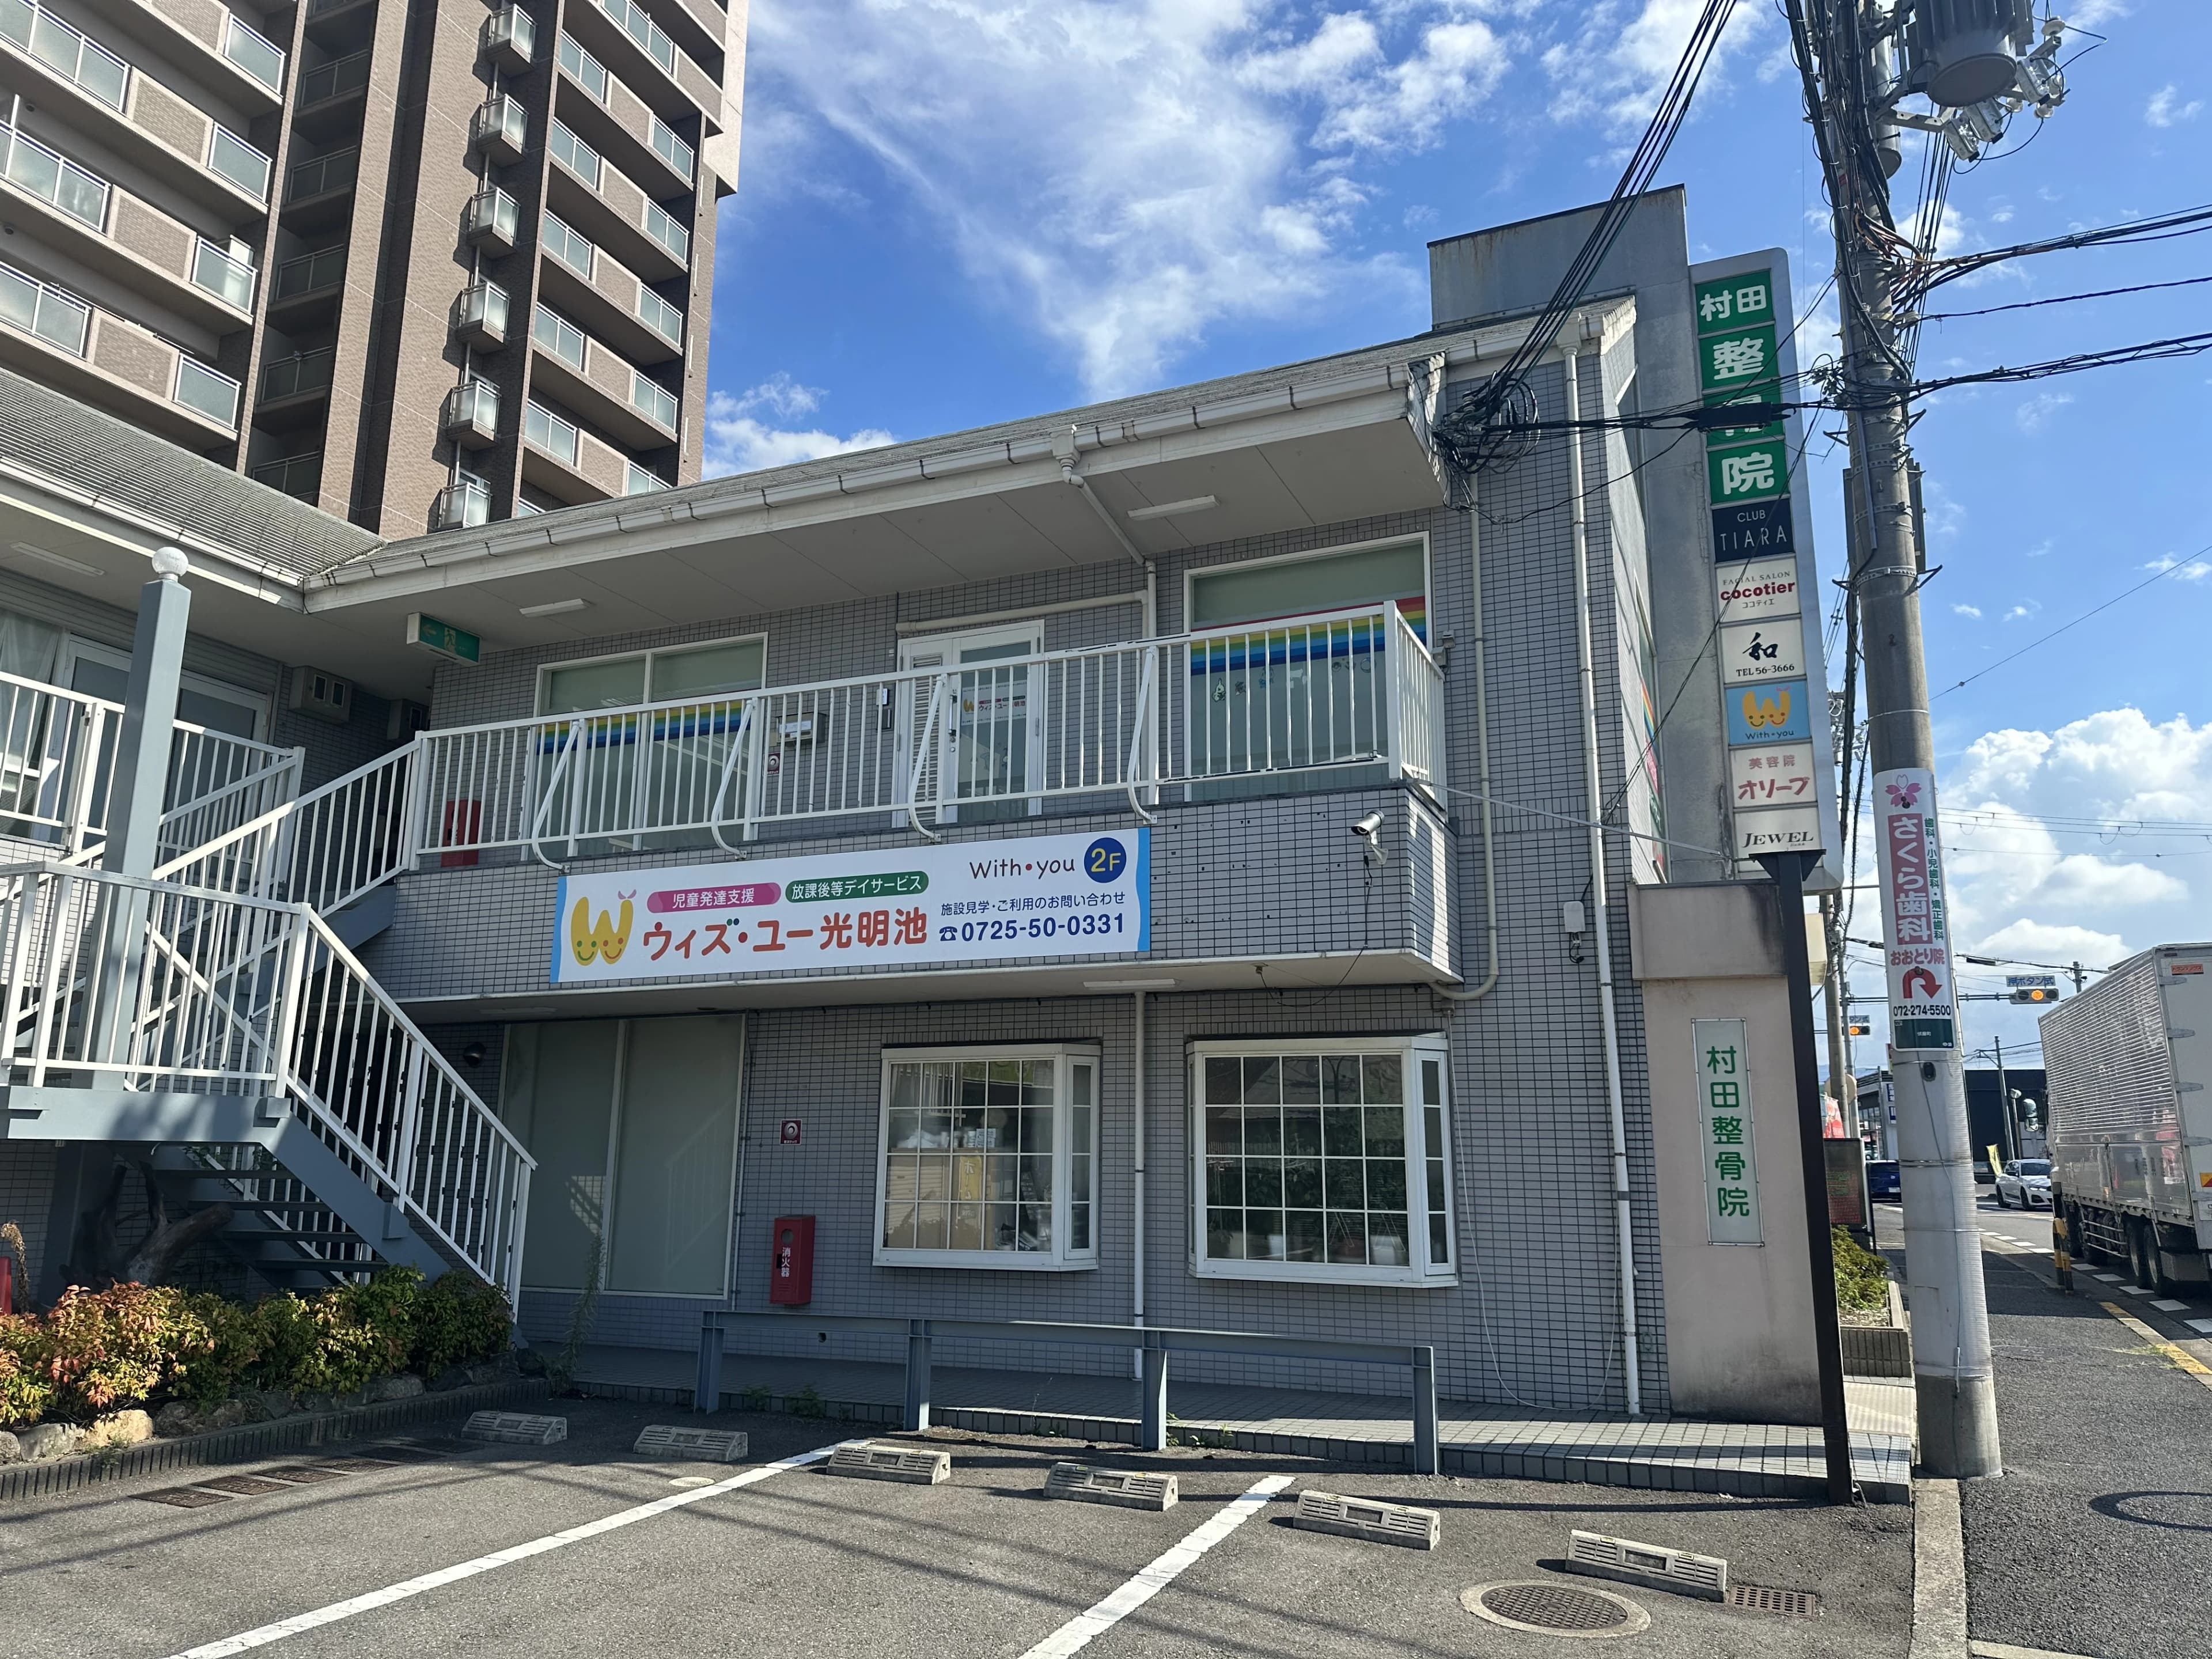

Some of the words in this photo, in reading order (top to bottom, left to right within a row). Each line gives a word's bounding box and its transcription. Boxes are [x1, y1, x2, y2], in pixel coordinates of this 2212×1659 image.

[1737, 509, 1766, 522] CLUB
[1719, 525, 1787, 551] TIARA
[1720, 582, 1796, 600] cocotier
[1723, 575, 1756, 586] FACIAL
[1759, 571, 1790, 581] SALON
[1742, 599, 1775, 608] ココティエ
[1743, 632, 1778, 661] 和
[1736, 668, 1754, 677] TEL
[1755, 664, 1795, 675] 56-3666
[1748, 755, 1796, 770] 美容院
[1741, 831, 1814, 849] JEWEL
[1090, 848, 1122, 873] 2F
[791, 875, 922, 900] 放課後等デイサービス
[1893, 817, 1930, 941] さくら歯科
[672, 888, 755, 909] 児童発達支援
[941, 891, 1126, 916] 施設見学・ご利用のお問い合わせ
[643, 906, 927, 961] ウィズ・ユー光明池
[961, 912, 1123, 942] 0725-50-0331
[1891, 948, 1945, 967] おおとり院
[1706, 1046, 1749, 1217] 村田整骨院
[781, 1247, 791, 1278] 消火器
